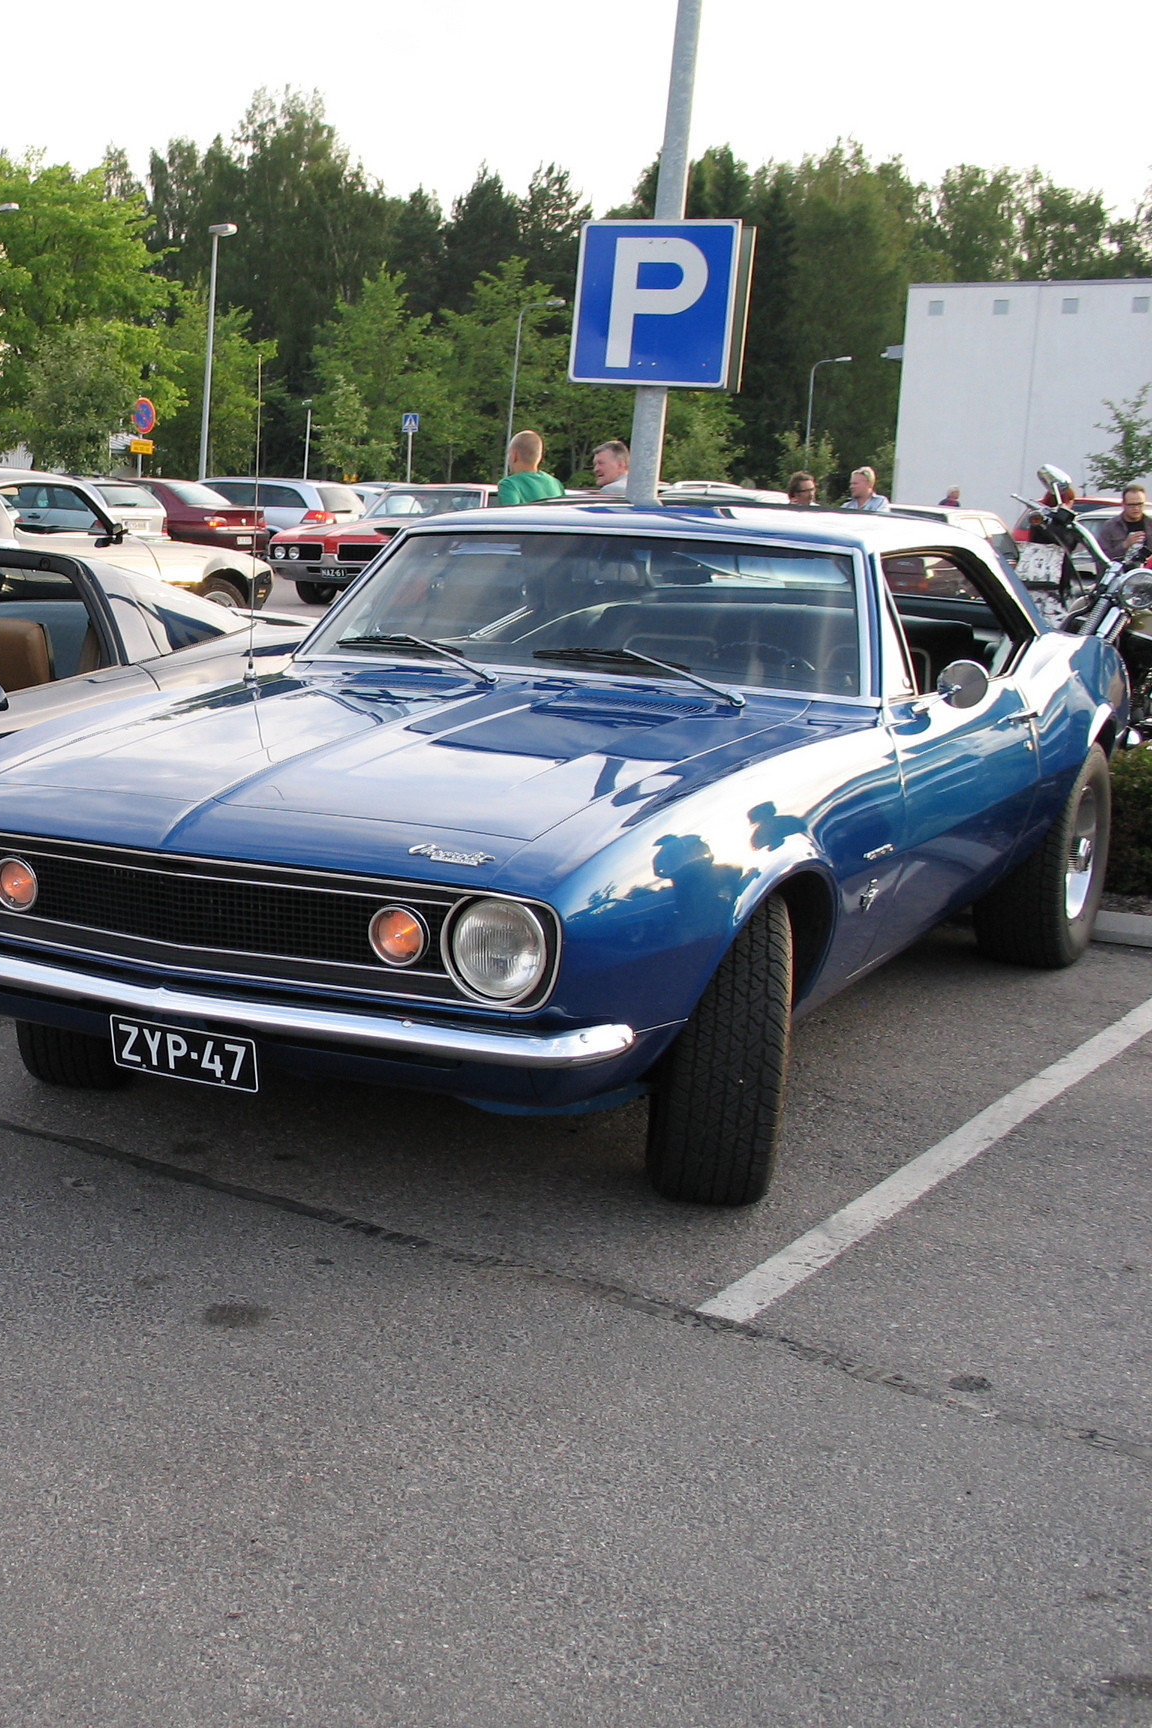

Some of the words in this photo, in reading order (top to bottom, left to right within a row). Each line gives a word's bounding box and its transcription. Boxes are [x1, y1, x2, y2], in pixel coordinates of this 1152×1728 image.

[605, 237, 709, 369] P
[322, 568, 345, 577] NAZ-61
[118, 1023, 248, 1082] ZYP-47
